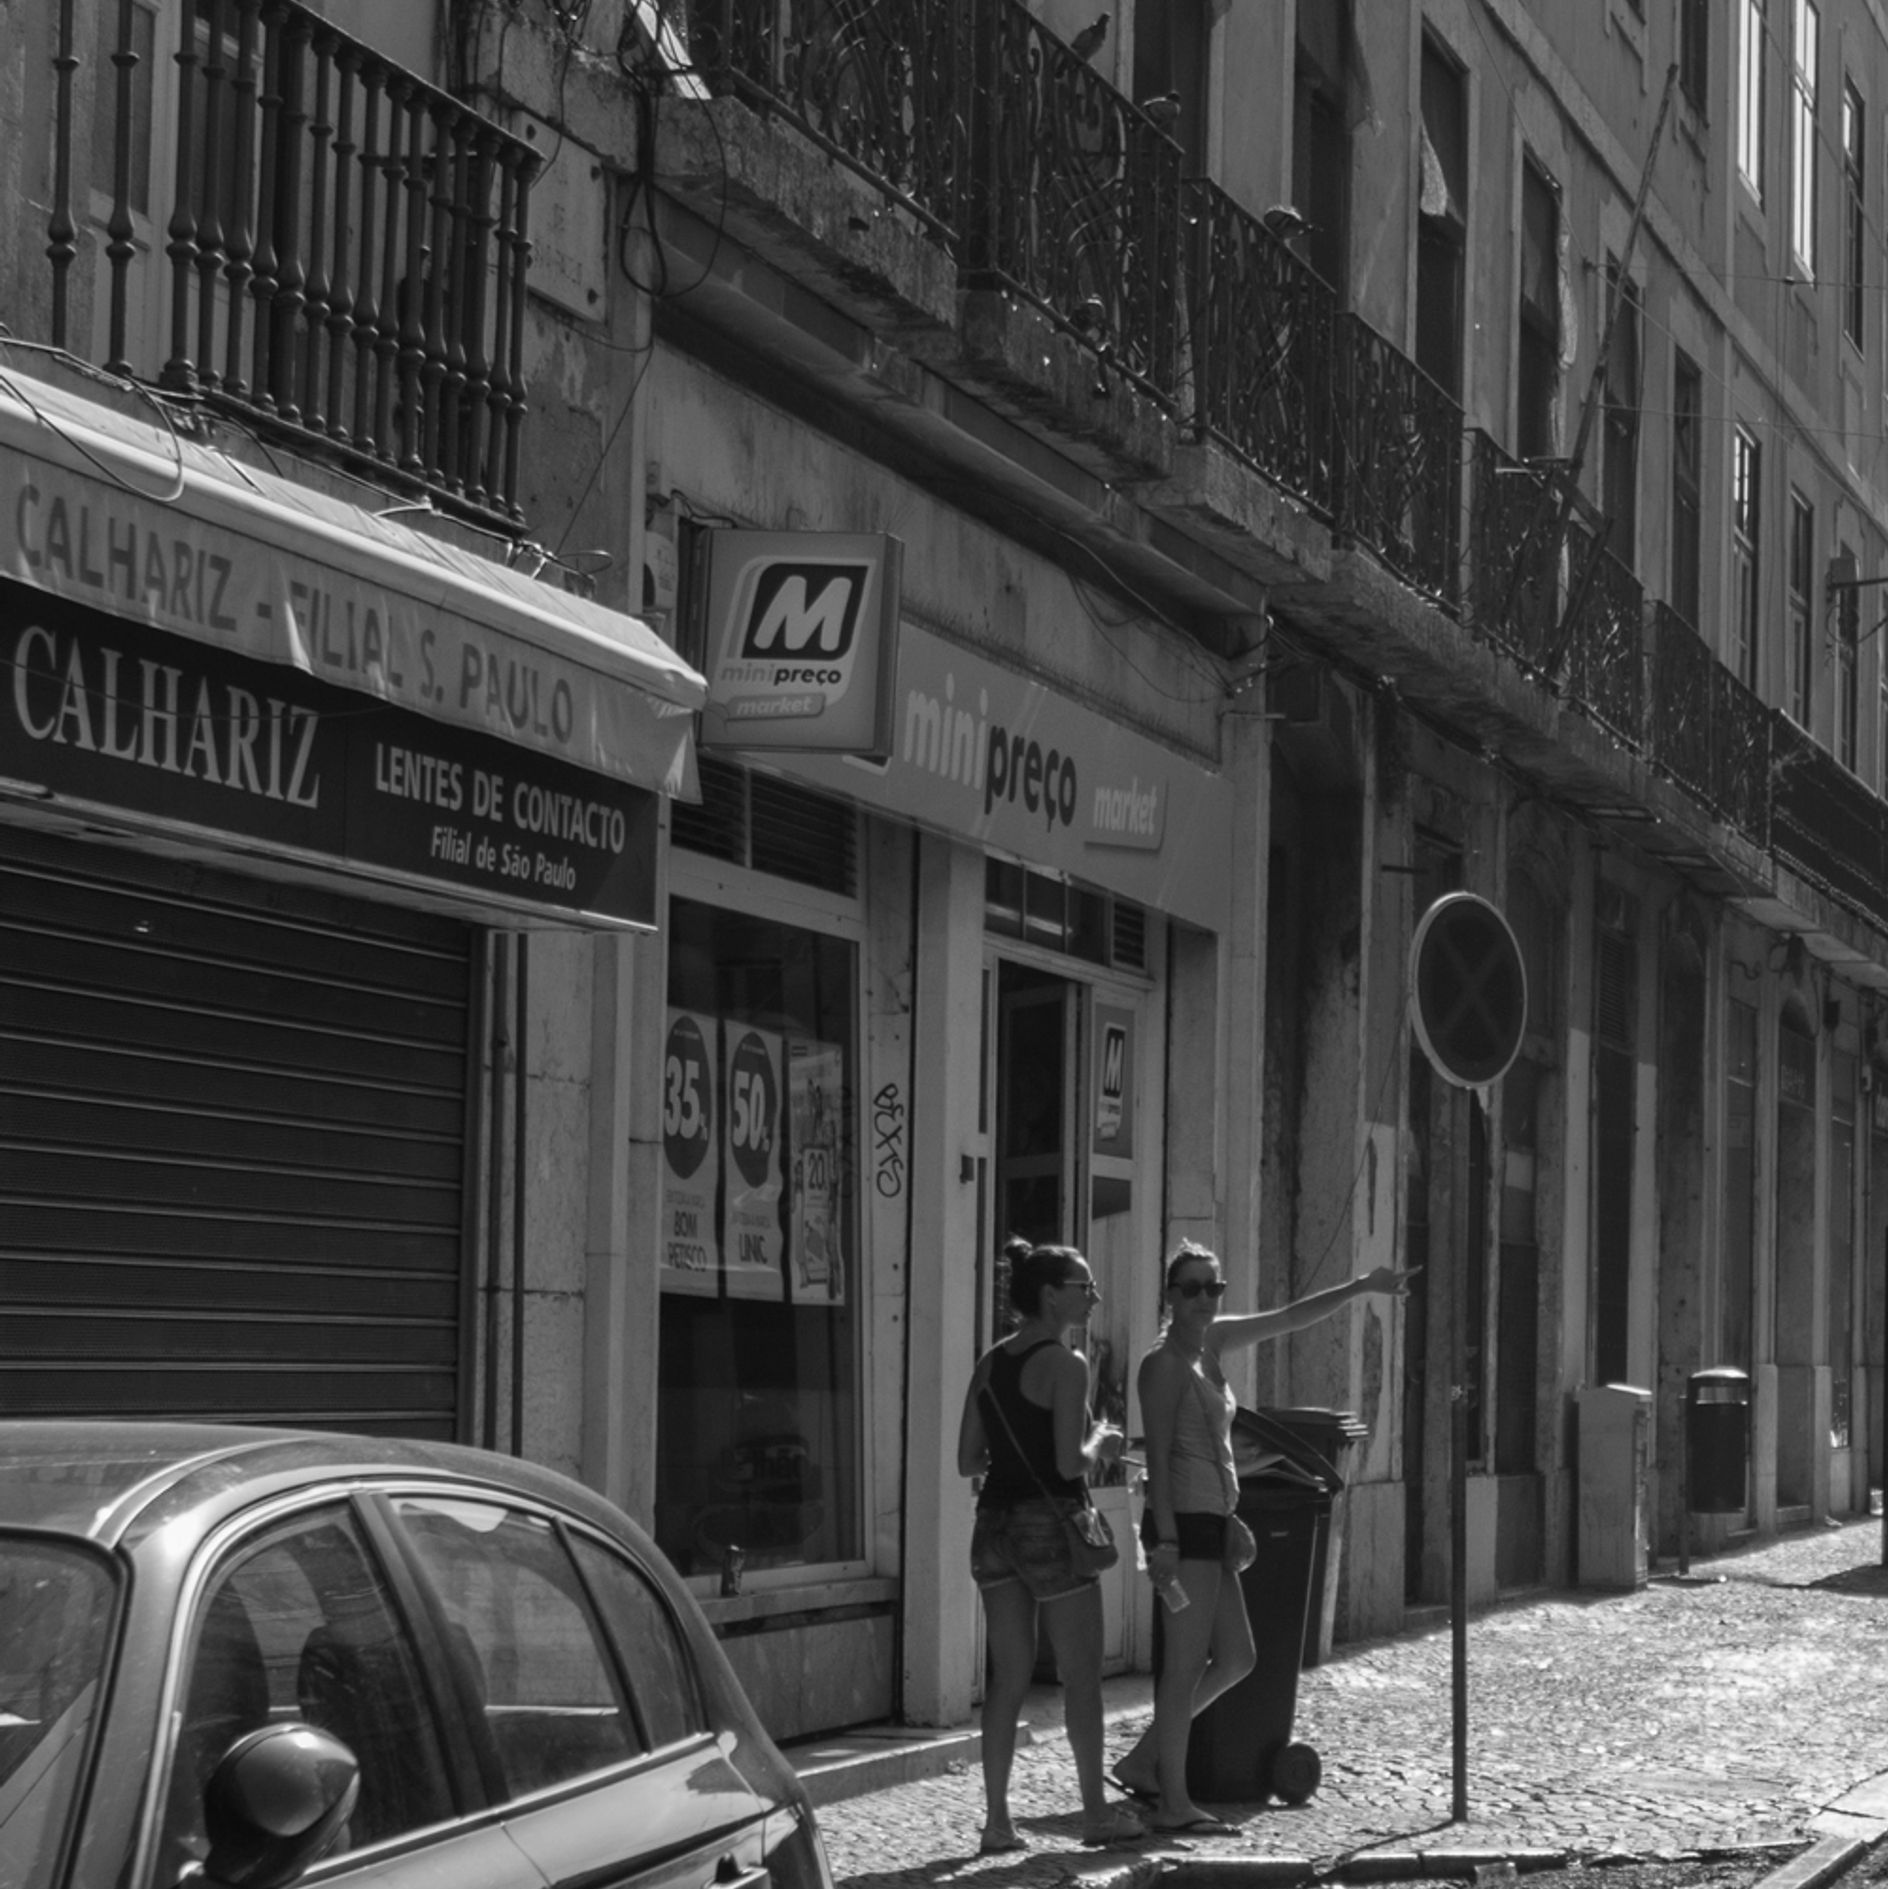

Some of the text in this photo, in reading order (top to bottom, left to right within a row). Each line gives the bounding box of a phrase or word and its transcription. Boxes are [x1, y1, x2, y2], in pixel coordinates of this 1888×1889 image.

[16, 483, 237, 632] CALHARIZ
[290, 580, 404, 688] FILIAL
[420, 629, 444, 703] S.
[459, 642, 573, 744] PAULO
[752, 574, 854, 652] M
[720, 662, 842, 687] minipreço
[736, 695, 814, 716] market
[13, 625, 321, 810] CALHARIZ
[903, 672, 1077, 833] minipreço
[375, 741, 626, 855] LENTES DE CONTACTO
[1092, 775, 1158, 836] market
[430, 825, 577, 891] Filial de São Paulo
[674, 1210, 698, 1238] BOM
